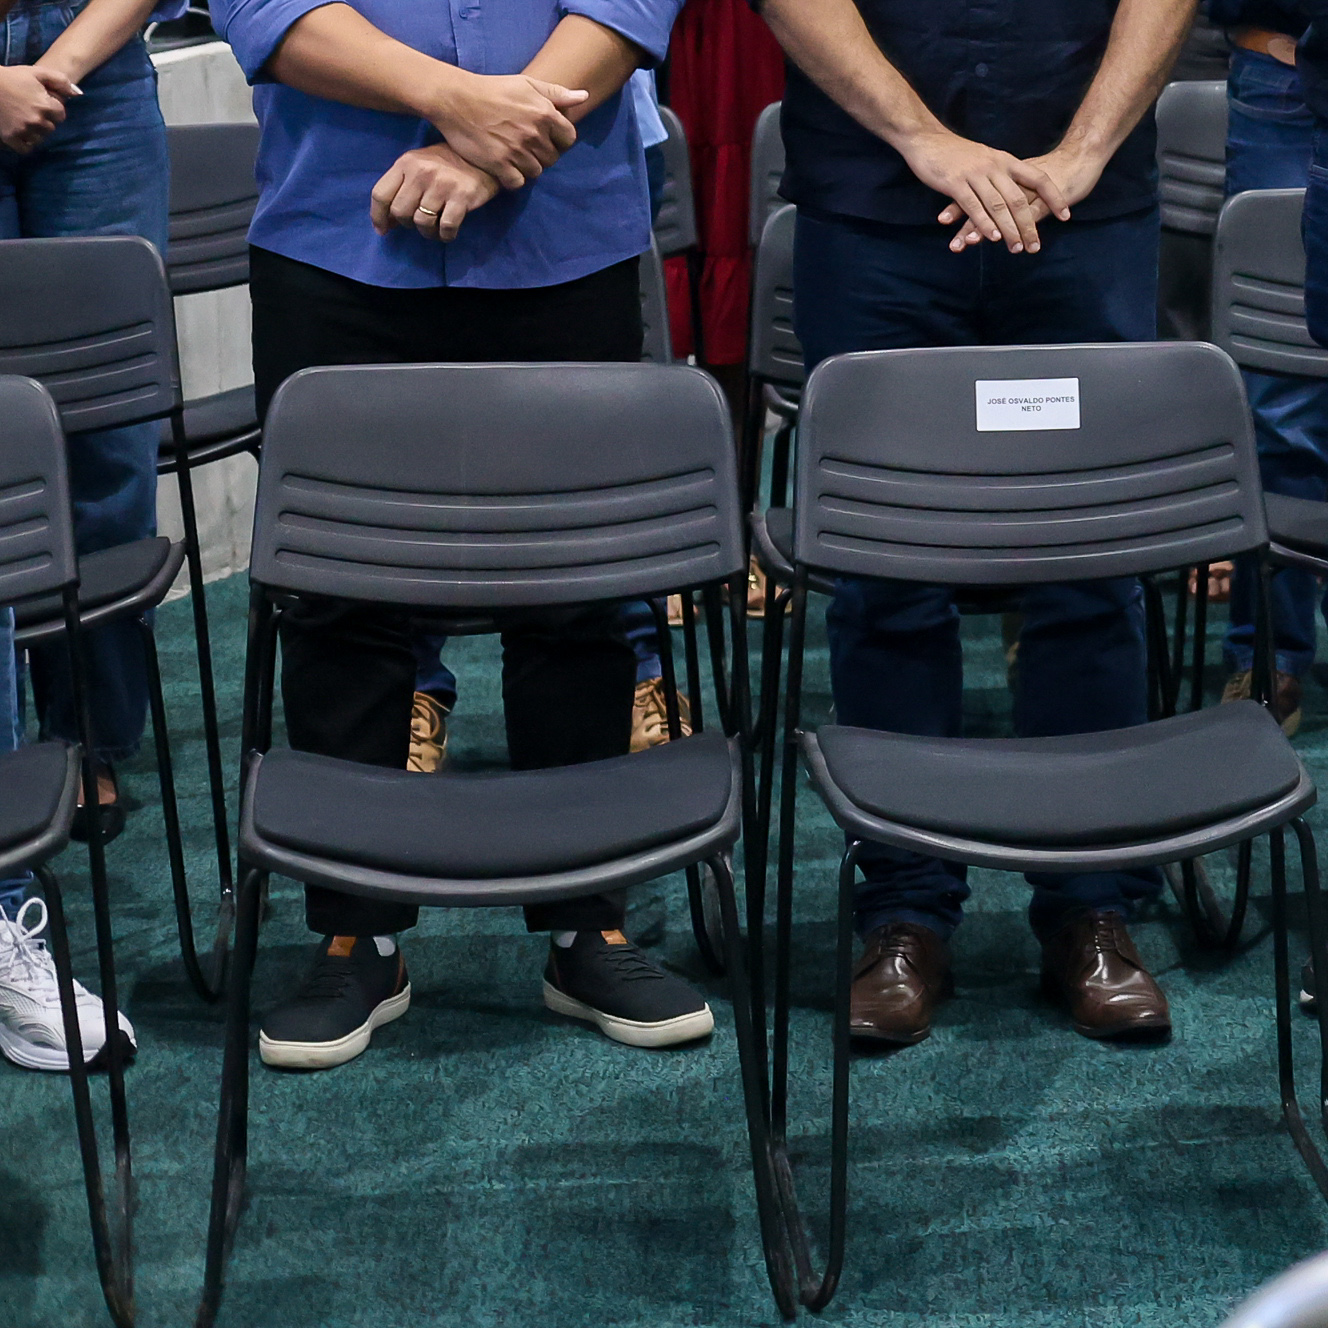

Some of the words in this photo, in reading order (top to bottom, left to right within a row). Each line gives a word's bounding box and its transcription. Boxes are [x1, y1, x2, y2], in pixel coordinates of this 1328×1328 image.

[987, 397, 1007, 405] JOSÉ
[1008, 397, 1044, 405] OSVALDO
[1045, 395, 1075, 403] PONTES
